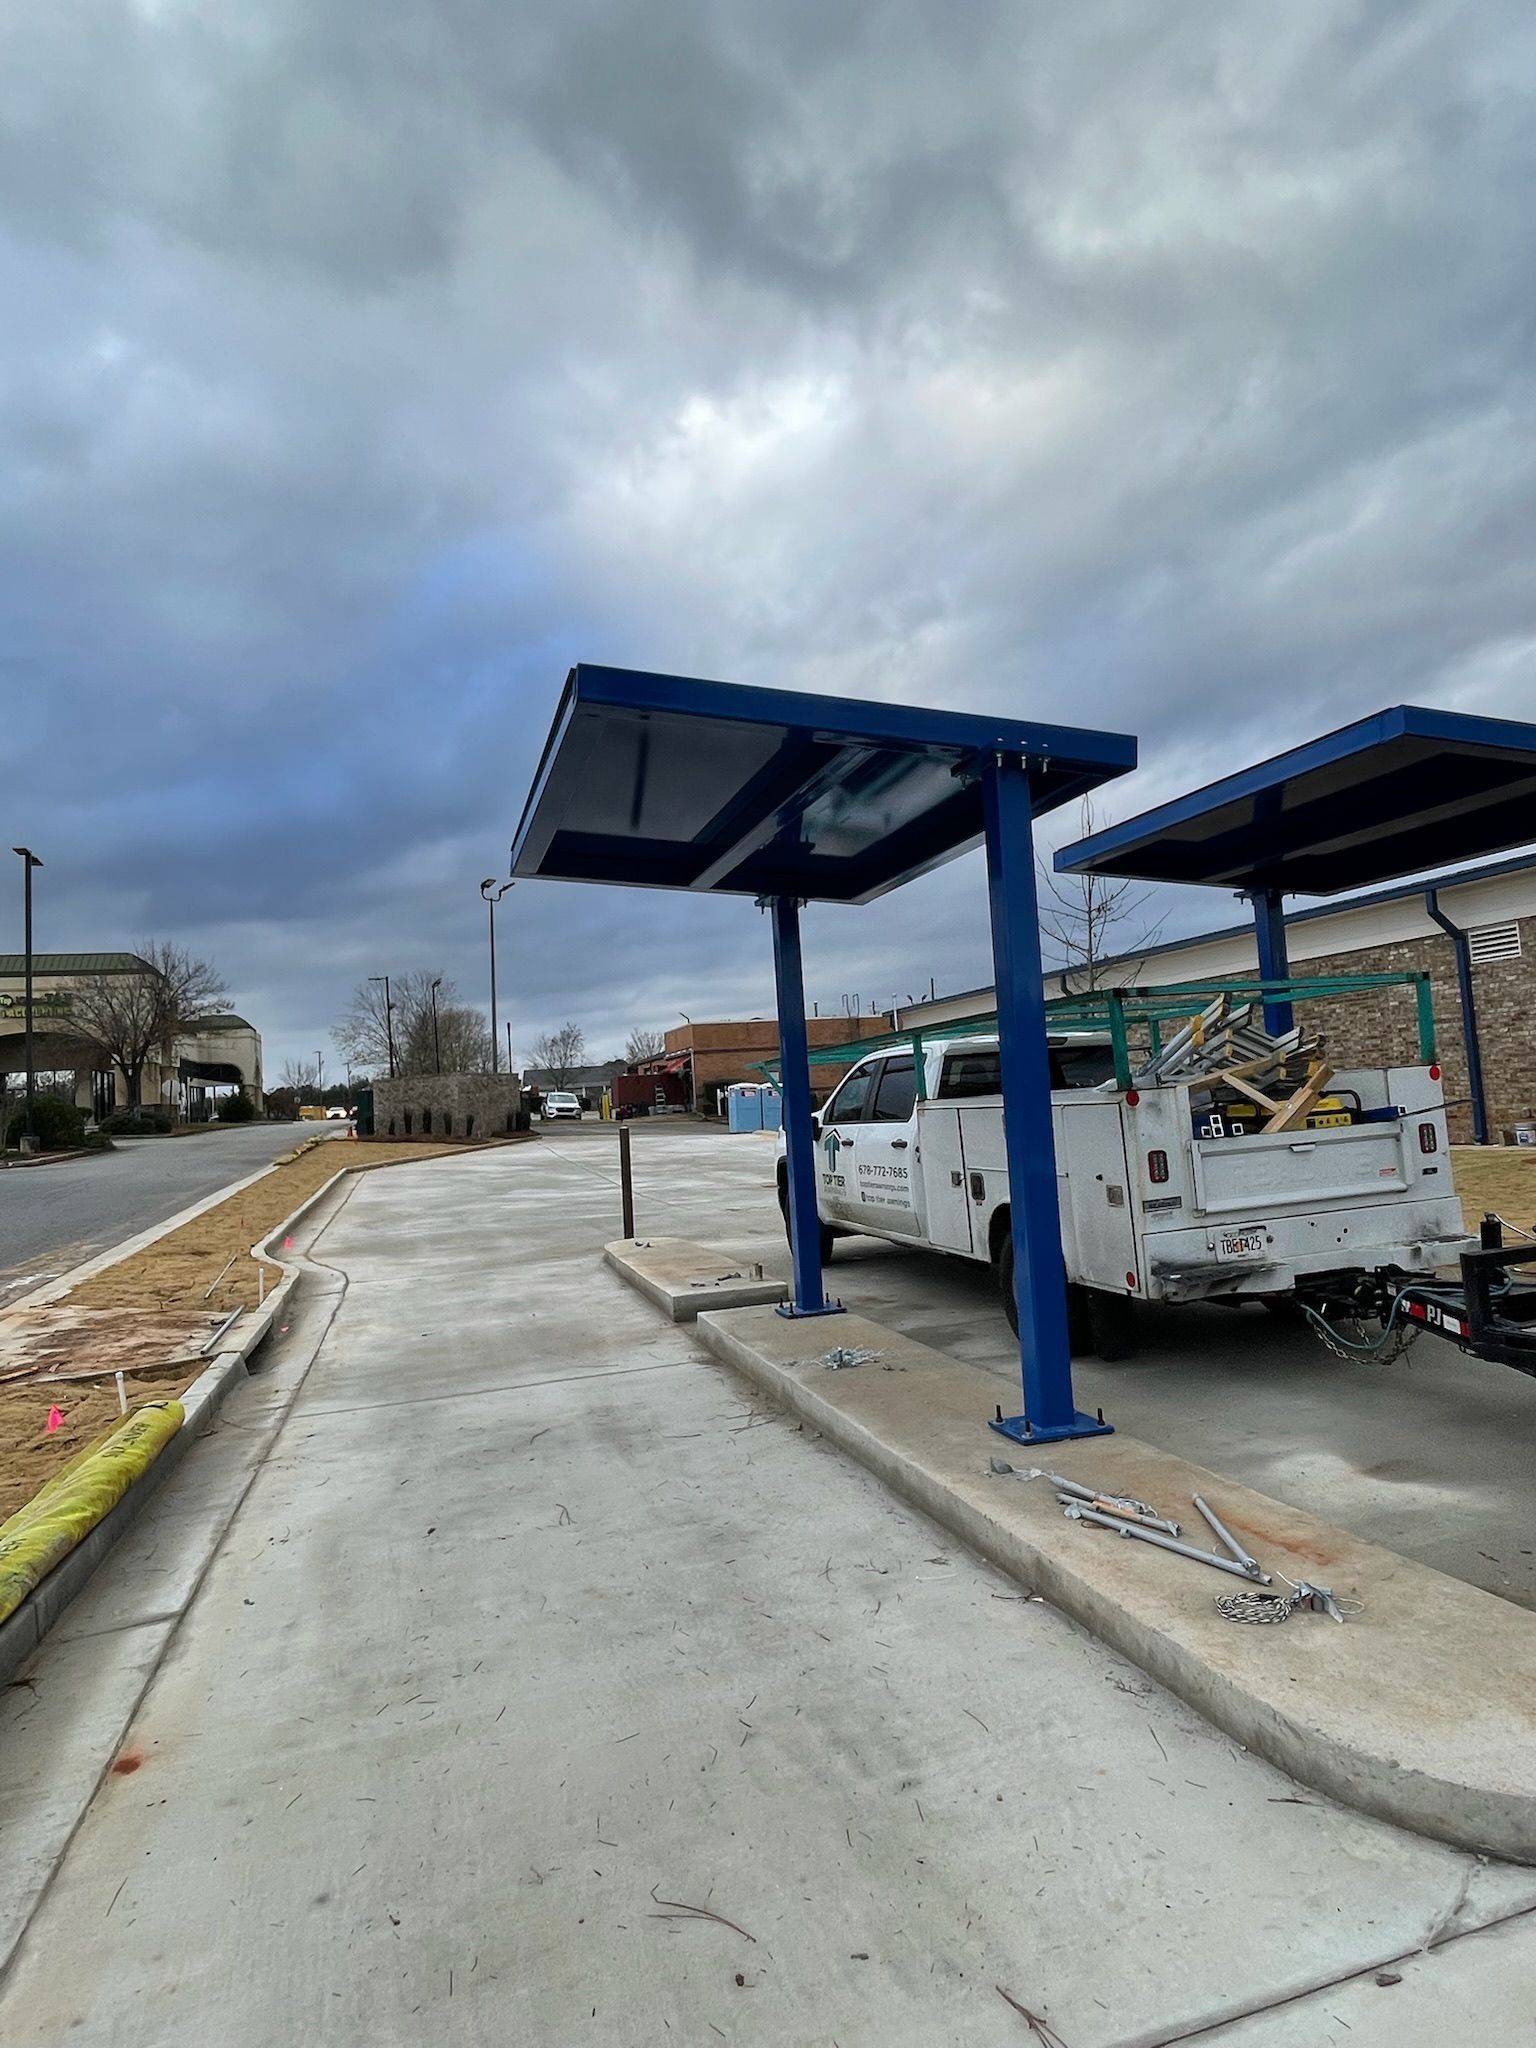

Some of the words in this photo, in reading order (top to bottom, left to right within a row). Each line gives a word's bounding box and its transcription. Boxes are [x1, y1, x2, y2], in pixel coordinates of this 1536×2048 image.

[858, 1164, 909, 1179] 678-772-7685
[822, 1173, 833, 1185] TOP
[834, 1174, 846, 1187] TIER
[1427, 1304, 1441, 1326] PJ
